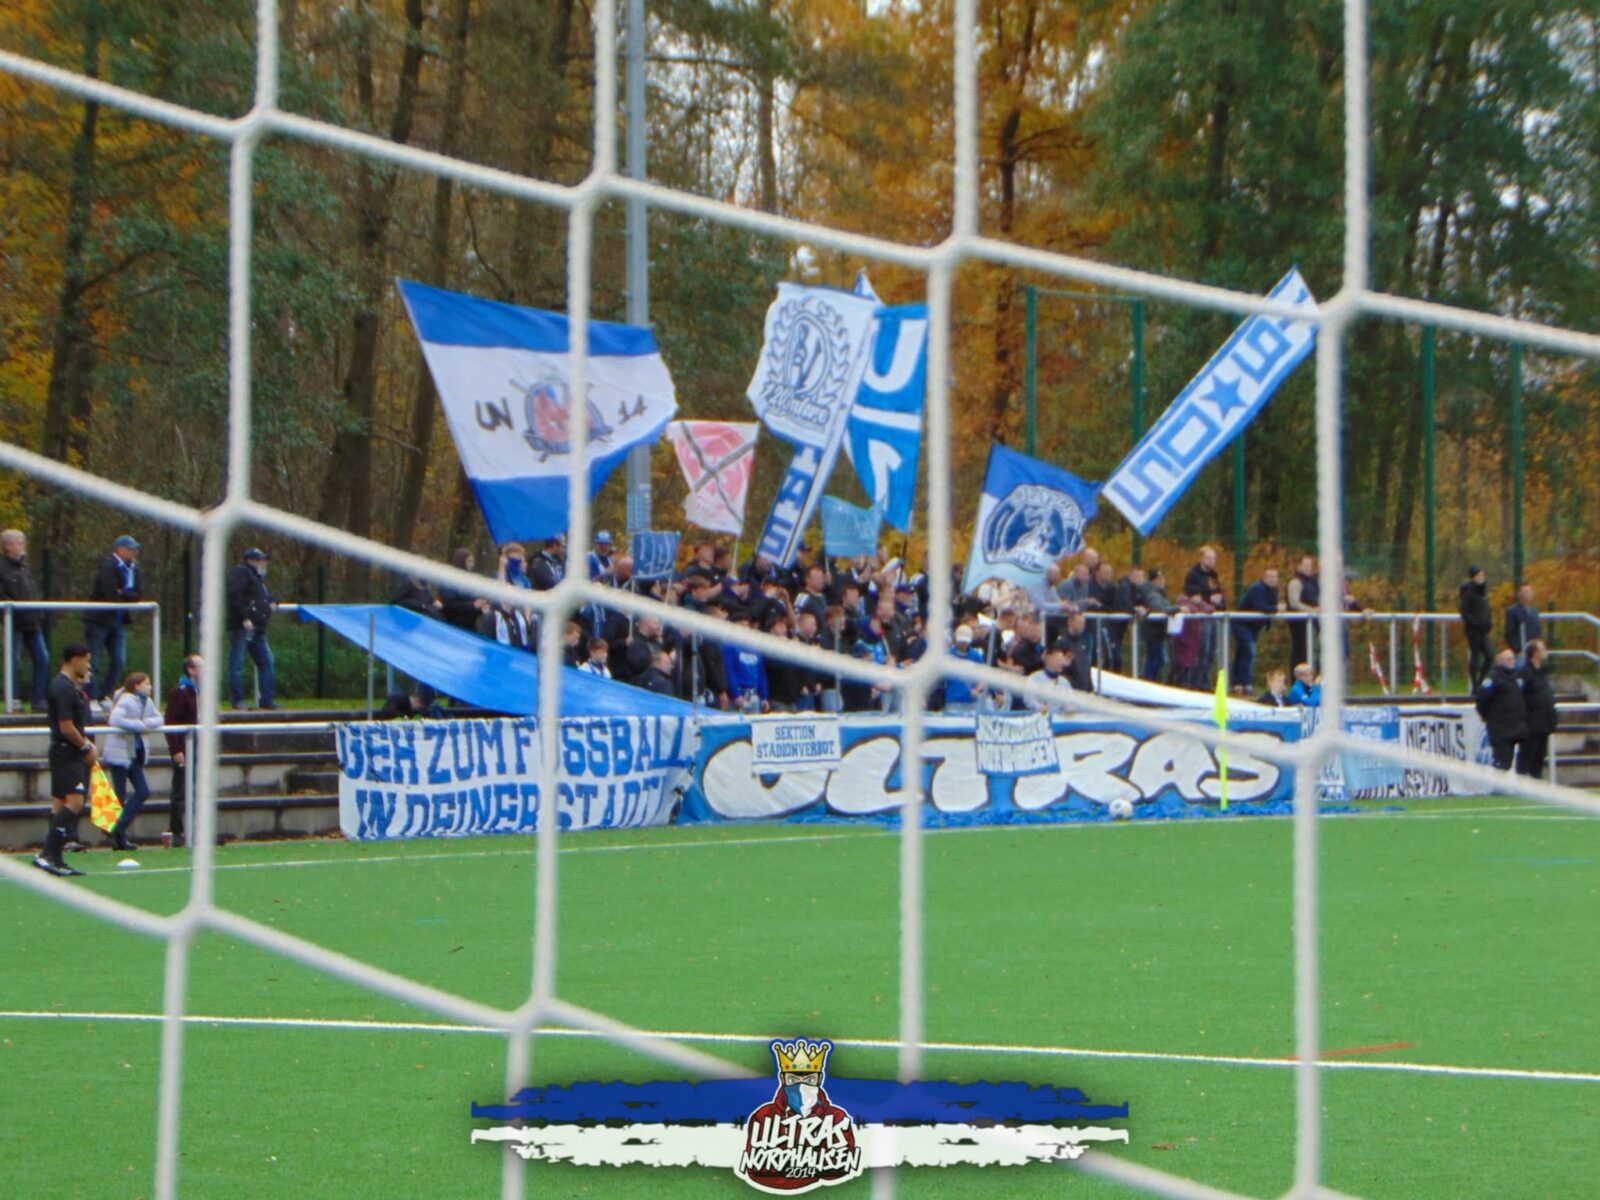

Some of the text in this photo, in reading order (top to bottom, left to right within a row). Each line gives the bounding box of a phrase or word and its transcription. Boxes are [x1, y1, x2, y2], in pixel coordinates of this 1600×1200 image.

[338, 716, 693, 785] GEH ZUM FSSBALL
[775, 725, 815, 741] SEKTION
[355, 789, 397, 840] IN
[402, 783, 541, 836] DEINER
